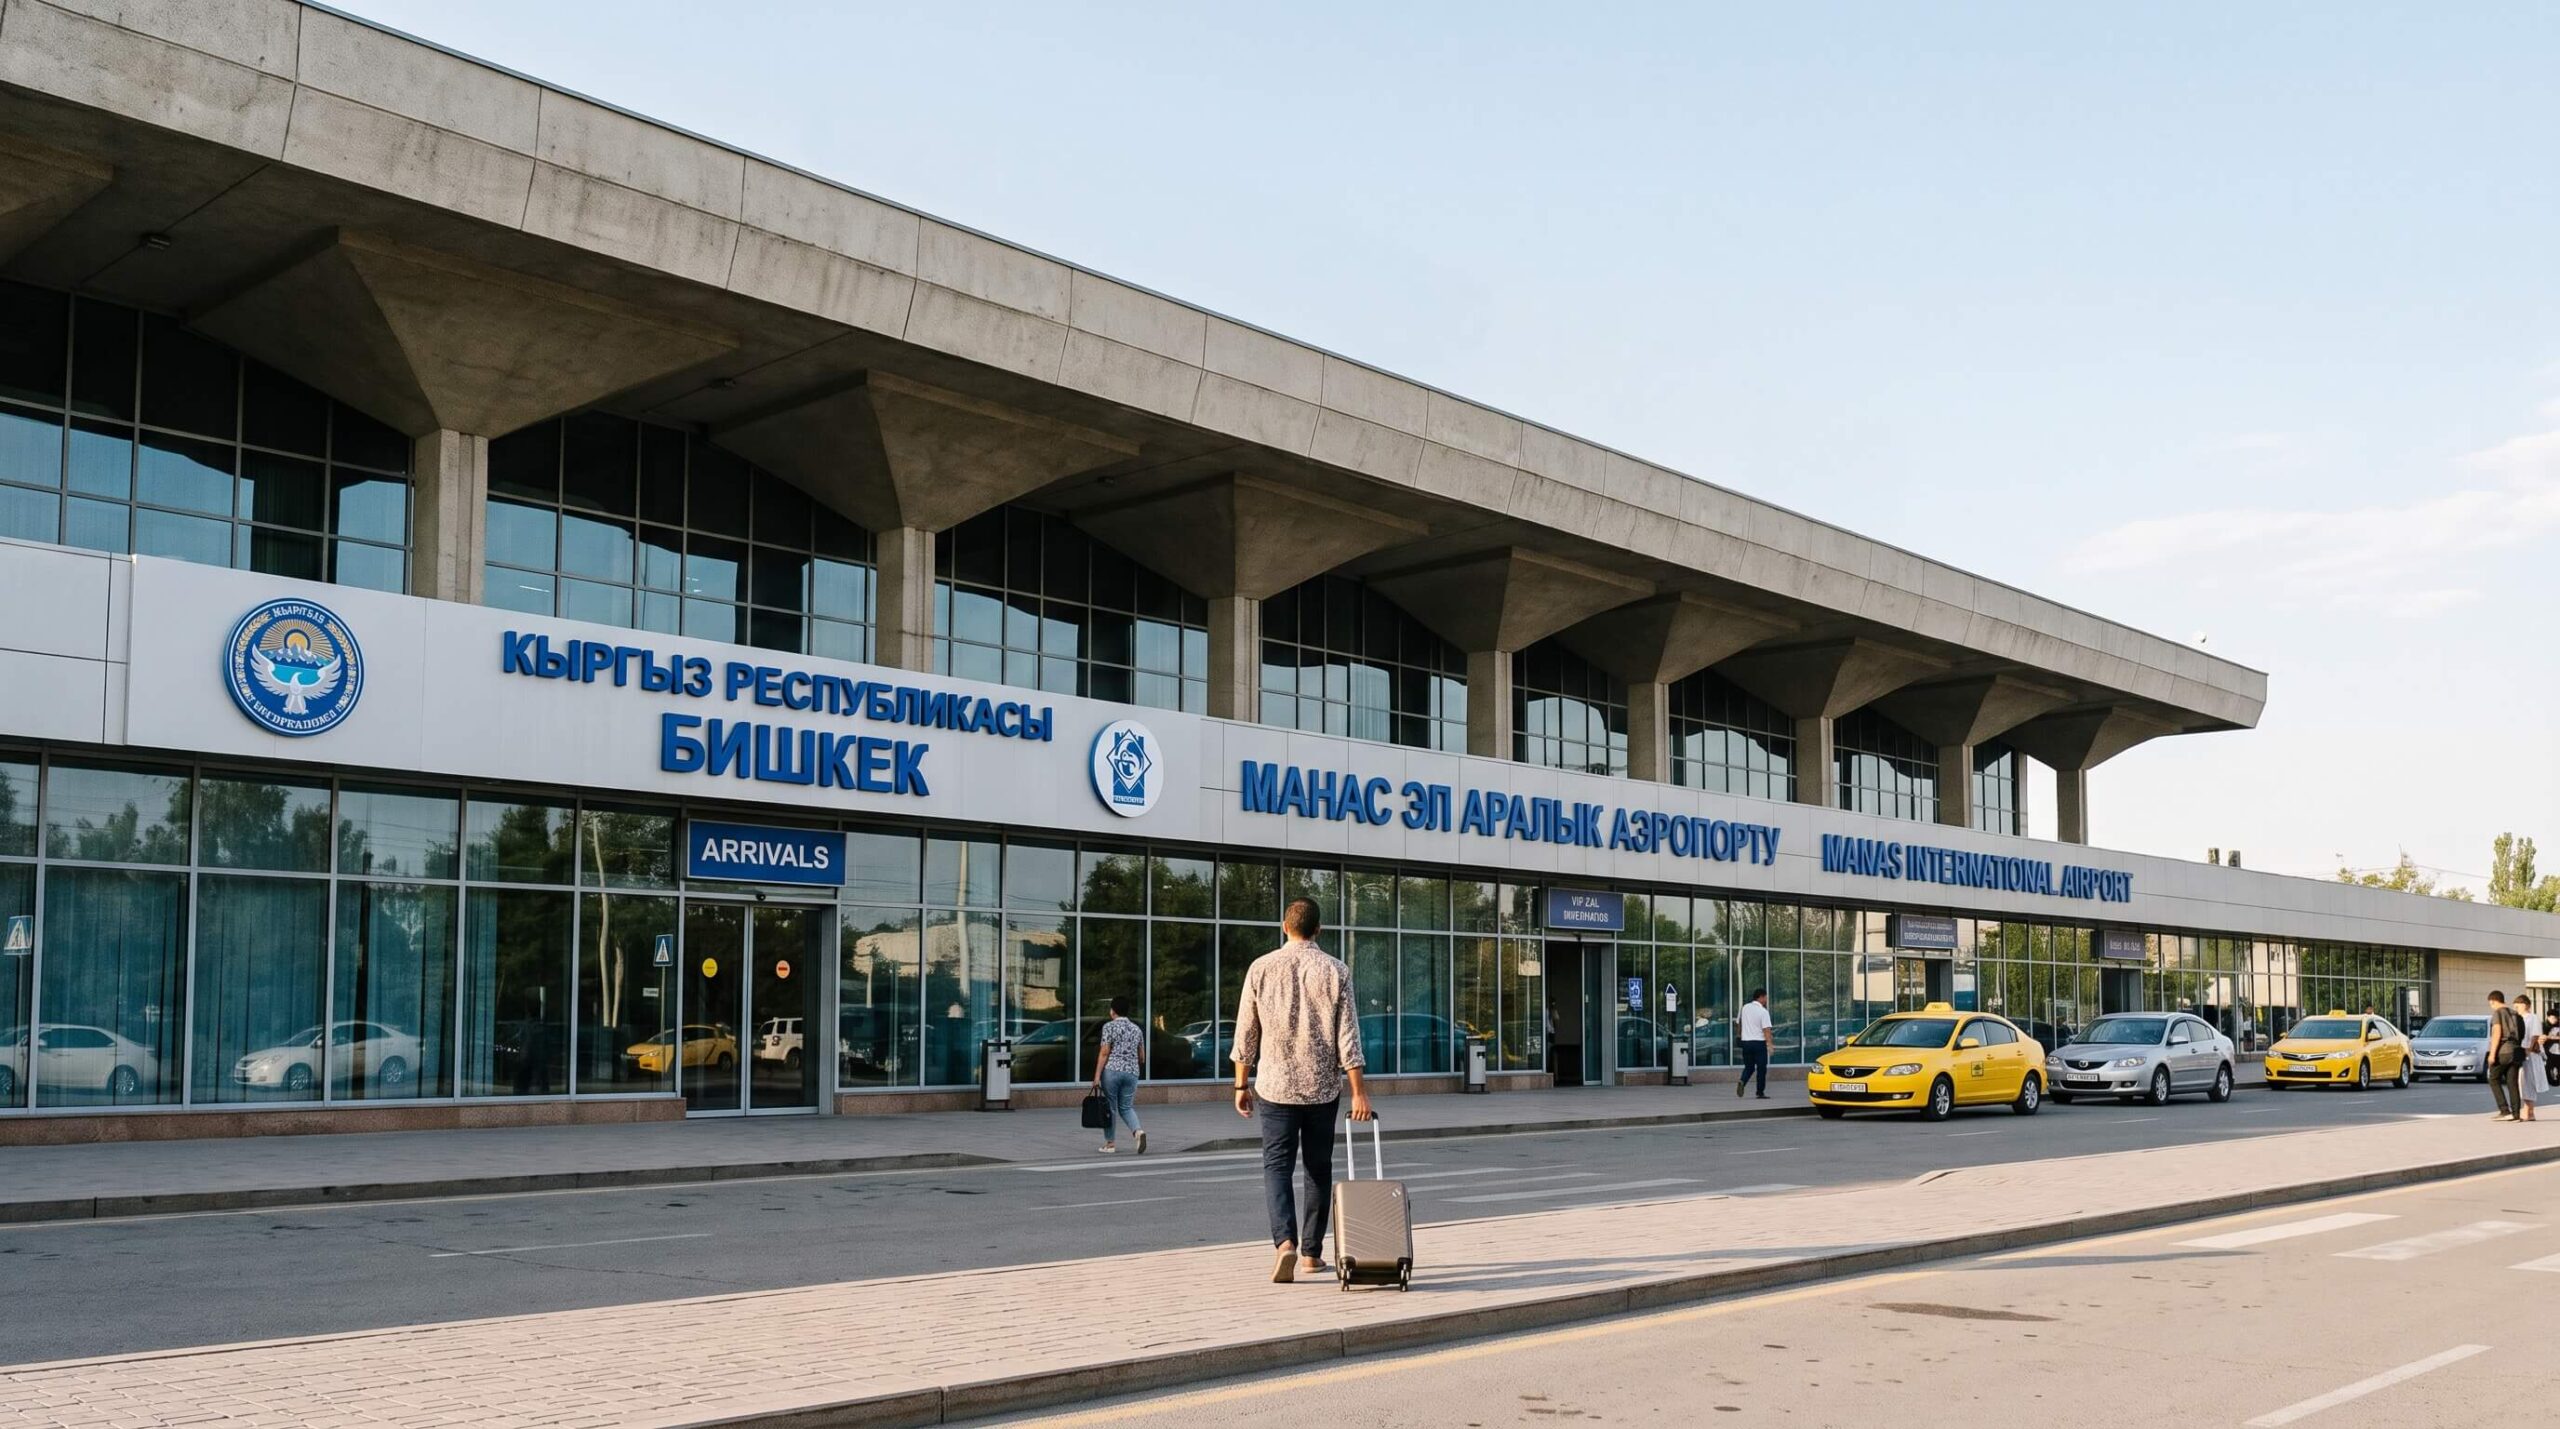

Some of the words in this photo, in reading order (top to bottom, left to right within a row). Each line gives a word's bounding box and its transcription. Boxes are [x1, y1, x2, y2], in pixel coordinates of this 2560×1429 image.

[503, 630, 713, 698] КЫРГЫЗ
[726, 661, 1053, 742] РЕСПУБЛИКАСЫ
[660, 712, 930, 796] БИШКЕК
[1241, 759, 1392, 826] МАНАС
[1400, 781, 1452, 832] ЭЛ
[1460, 788, 1603, 848] АРАЛЫК
[1609, 807, 1781, 866] АЭРОПОРТУ
[701, 838, 829, 869] ARRIVALS
[1822, 833, 1903, 879] MANAS
[1905, 844, 2059, 896] INTERNATIONAL
[2060, 864, 2134, 903] AIRPORT
[1571, 895, 1584, 907] VIP
